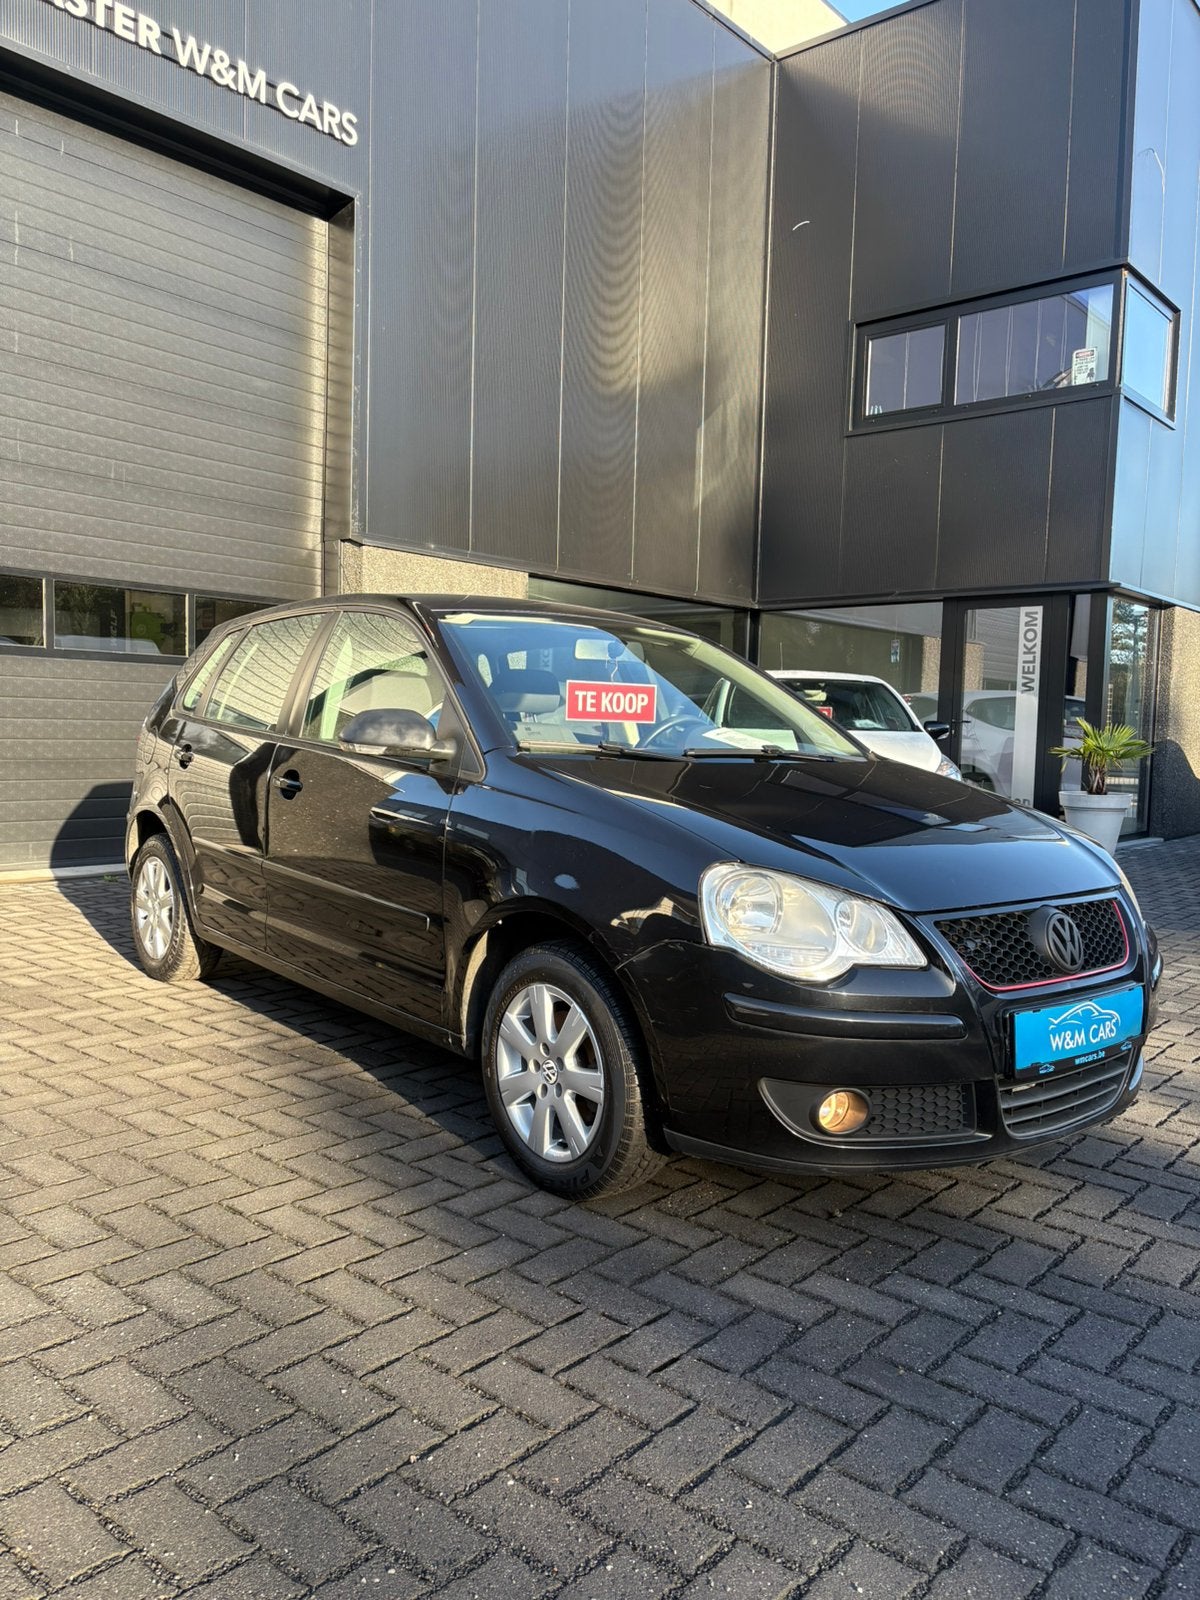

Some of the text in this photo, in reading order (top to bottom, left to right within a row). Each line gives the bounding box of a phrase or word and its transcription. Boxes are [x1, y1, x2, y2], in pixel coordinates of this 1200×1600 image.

[53, 0, 358, 146] STER W&M CARS
[1021, 611, 1039, 694] WELKOM
[575, 691, 649, 714] TE KOOP
[1050, 1020, 1117, 1051] W&M CARS
[1075, 1050, 1105, 1065] wmcars.be
